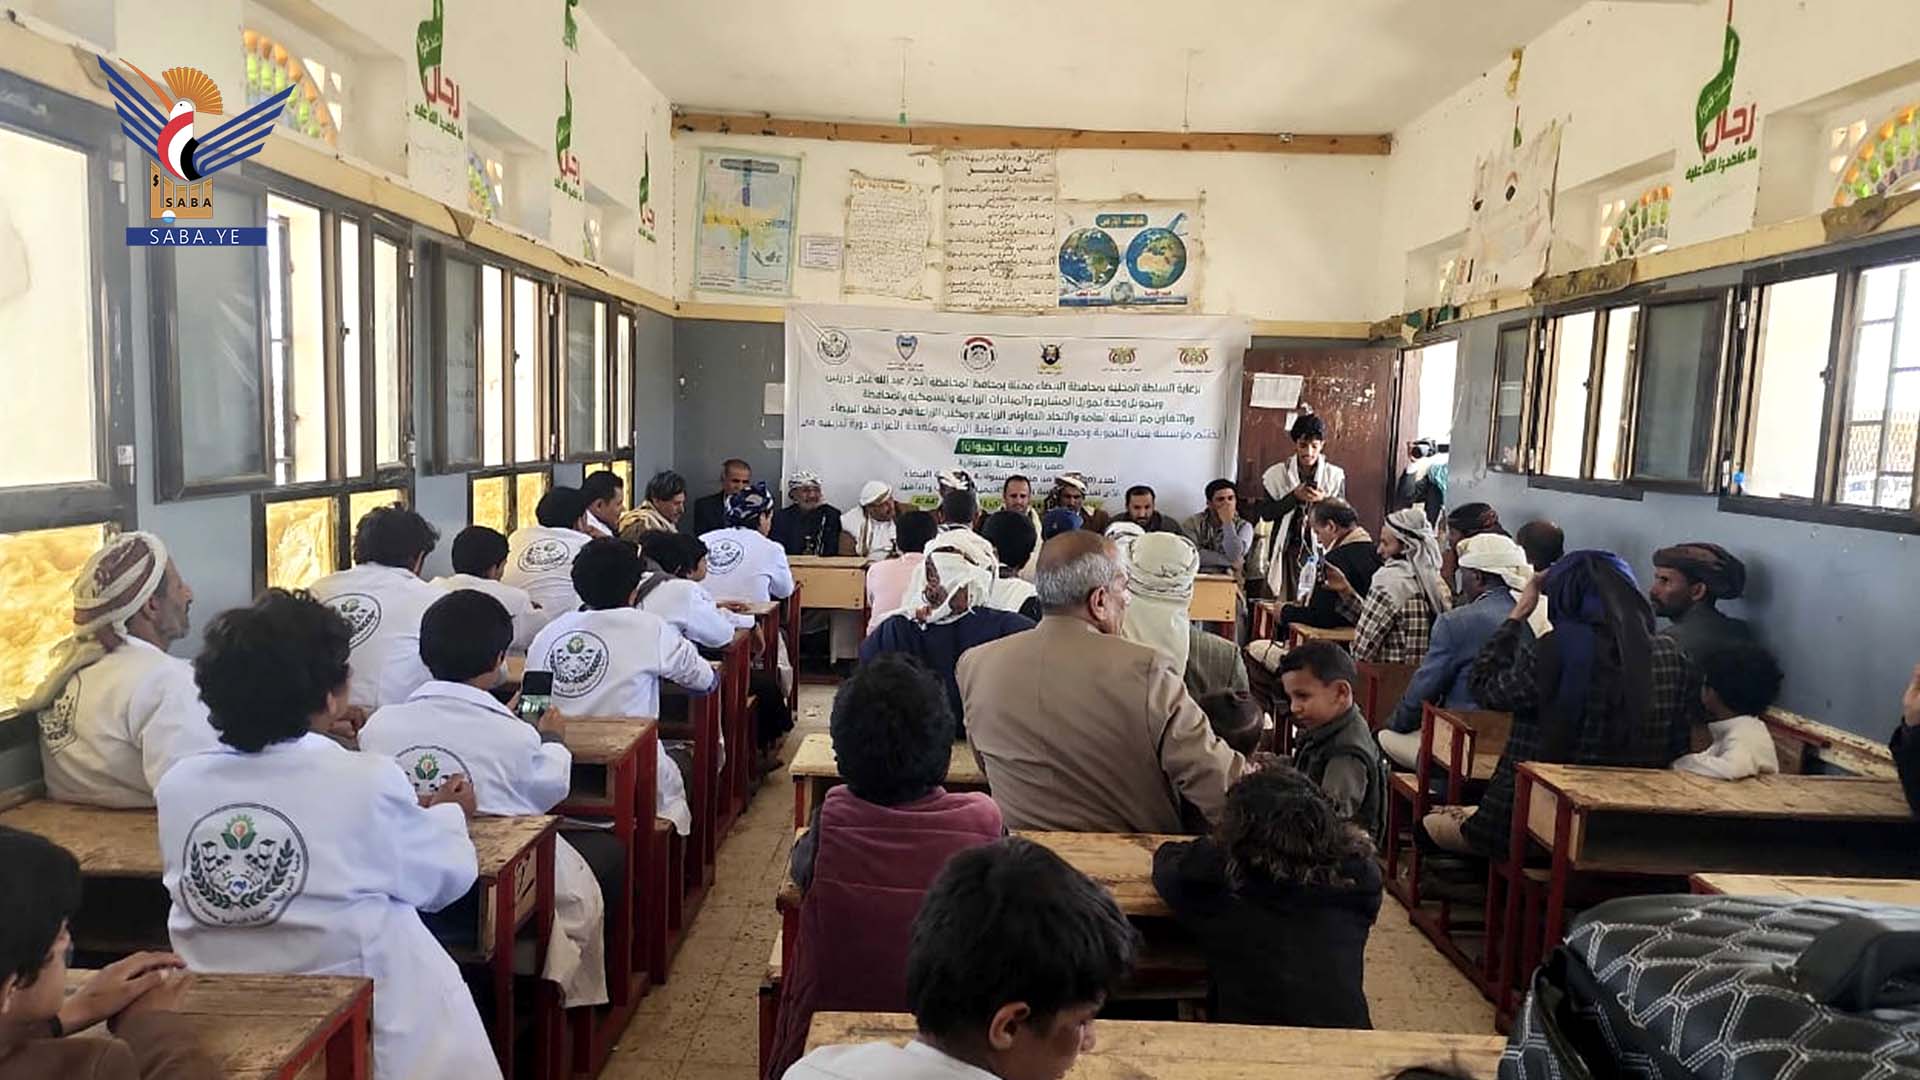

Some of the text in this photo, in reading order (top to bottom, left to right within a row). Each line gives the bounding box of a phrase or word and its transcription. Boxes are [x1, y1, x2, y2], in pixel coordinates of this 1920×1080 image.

[424, 65, 460, 119] رجال
[1702, 102, 1756, 154] رجال
[1748, 148, 1757, 161] ما
[1703, 157, 1717, 175] الله
[1685, 164, 1702, 183] عليه
[855, 374, 873, 386] علي
[875, 374, 889, 385] الله
[1036, 380, 1065, 391] البيضاء
[1068, 381, 1105, 393] بمحافظة
[1108, 382, 1140, 393] المحلية
[1142, 383, 1175, 393] السلطة
[1177, 383, 1201, 395] برعاية
[957, 394, 987, 406] الزراعية
[989, 394, 1032, 407] والمبادرات
[1034, 396, 1074, 408] المشاريع
[831, 402, 860, 414] البيضاء
[862, 403, 896, 416] محافظة
[898, 406, 913, 416] في
[1140, 415, 1153, 425] مع
